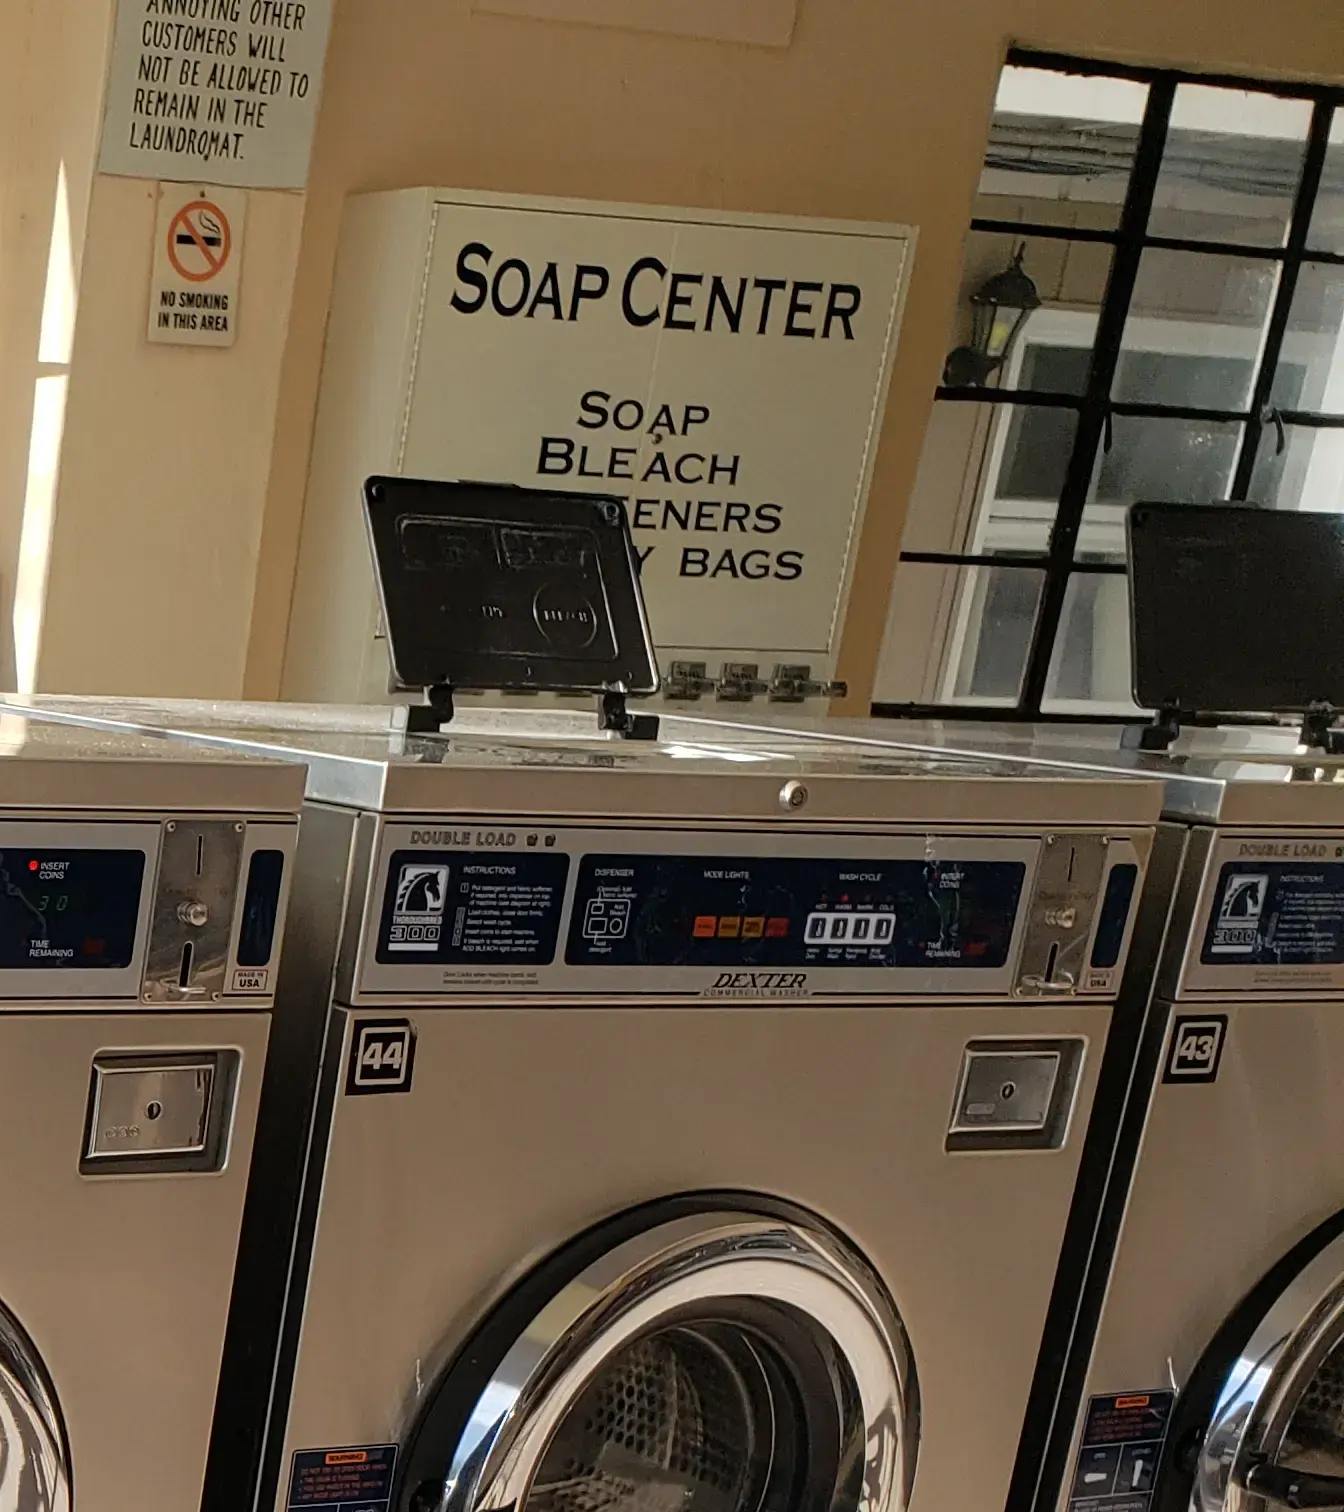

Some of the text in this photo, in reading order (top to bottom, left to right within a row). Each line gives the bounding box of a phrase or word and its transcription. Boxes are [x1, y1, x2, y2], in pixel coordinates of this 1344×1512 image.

[249, 0, 306, 31] OTHER
[142, 21, 286, 63] CUSTOMERS WILL
[137, 54, 309, 99] NOT BE ALLOWED TO
[132, 88, 269, 129] REMAIN IN THE
[129, 122, 245, 160] LAUNDROMAT.
[450, 241, 863, 341] SOAP CENTER
[160, 291, 228, 311] NO SMOKING
[157, 314, 228, 332] IN THIS AREA
[576, 389, 711, 437] SOAP
[536, 436, 741, 486] BLEACH
[678, 546, 805, 582] BAGS
[409, 830, 517, 847] DOUBLE LOAD
[1238, 843, 1327, 857] DOUBLE LOAD
[40, 861, 70, 871] INSERT
[463, 866, 517, 875] INSTRUCTIONS
[594, 868, 635, 877] DISPENSER
[703, 870, 750, 879] MODE LIGHTS
[38, 871, 65, 880] COINS
[389, 925, 441, 942] 300
[30, 939, 50, 948] TIME
[29, 948, 74, 957] REMAINING
[239, 979, 260, 988] USA
[712, 973, 807, 989] DEXTER
[703, 988, 809, 997] COMMERCIAL WASHER
[362, 1041, 404, 1070] 44
[1177, 1033, 1215, 1062] 43
